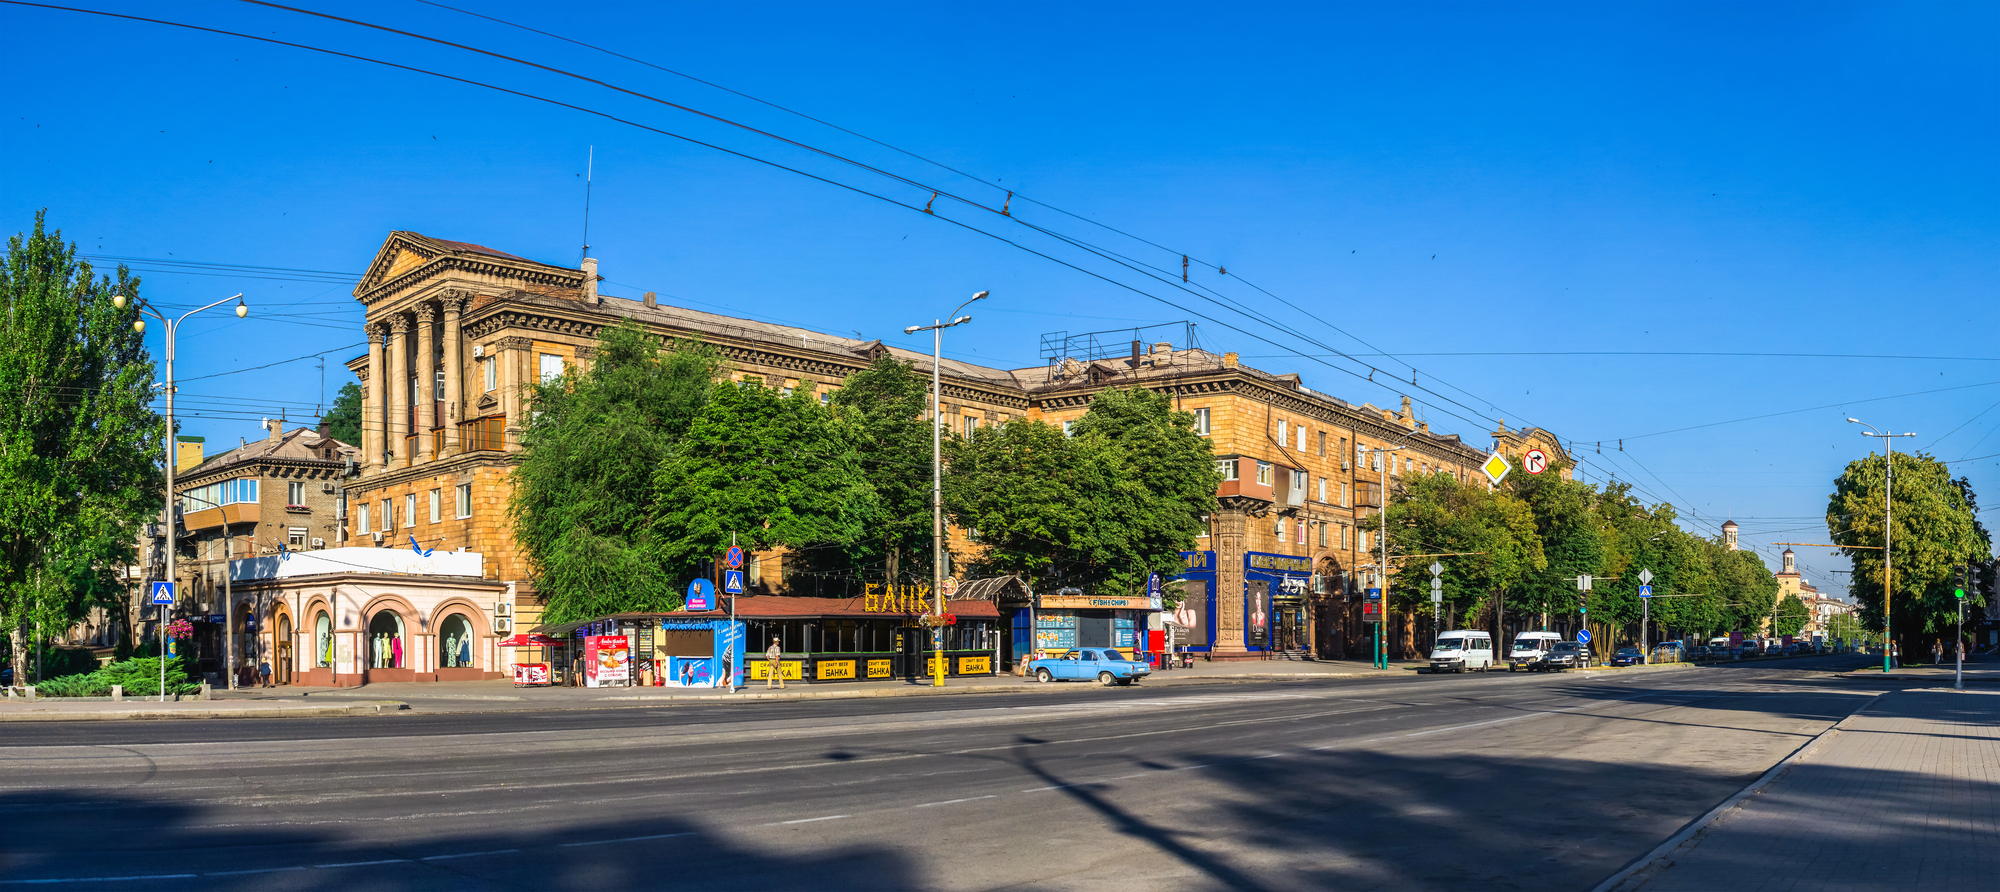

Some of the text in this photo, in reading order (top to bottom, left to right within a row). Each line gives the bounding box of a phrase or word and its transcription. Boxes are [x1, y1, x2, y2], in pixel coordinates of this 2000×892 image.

[1250, 554, 1312, 573] ЮВЕЛИРНЫЙ
[825, 668, 848, 677] БАНКА
[868, 667, 890, 676] БАНКА
[965, 664, 985, 672] БАНКА
